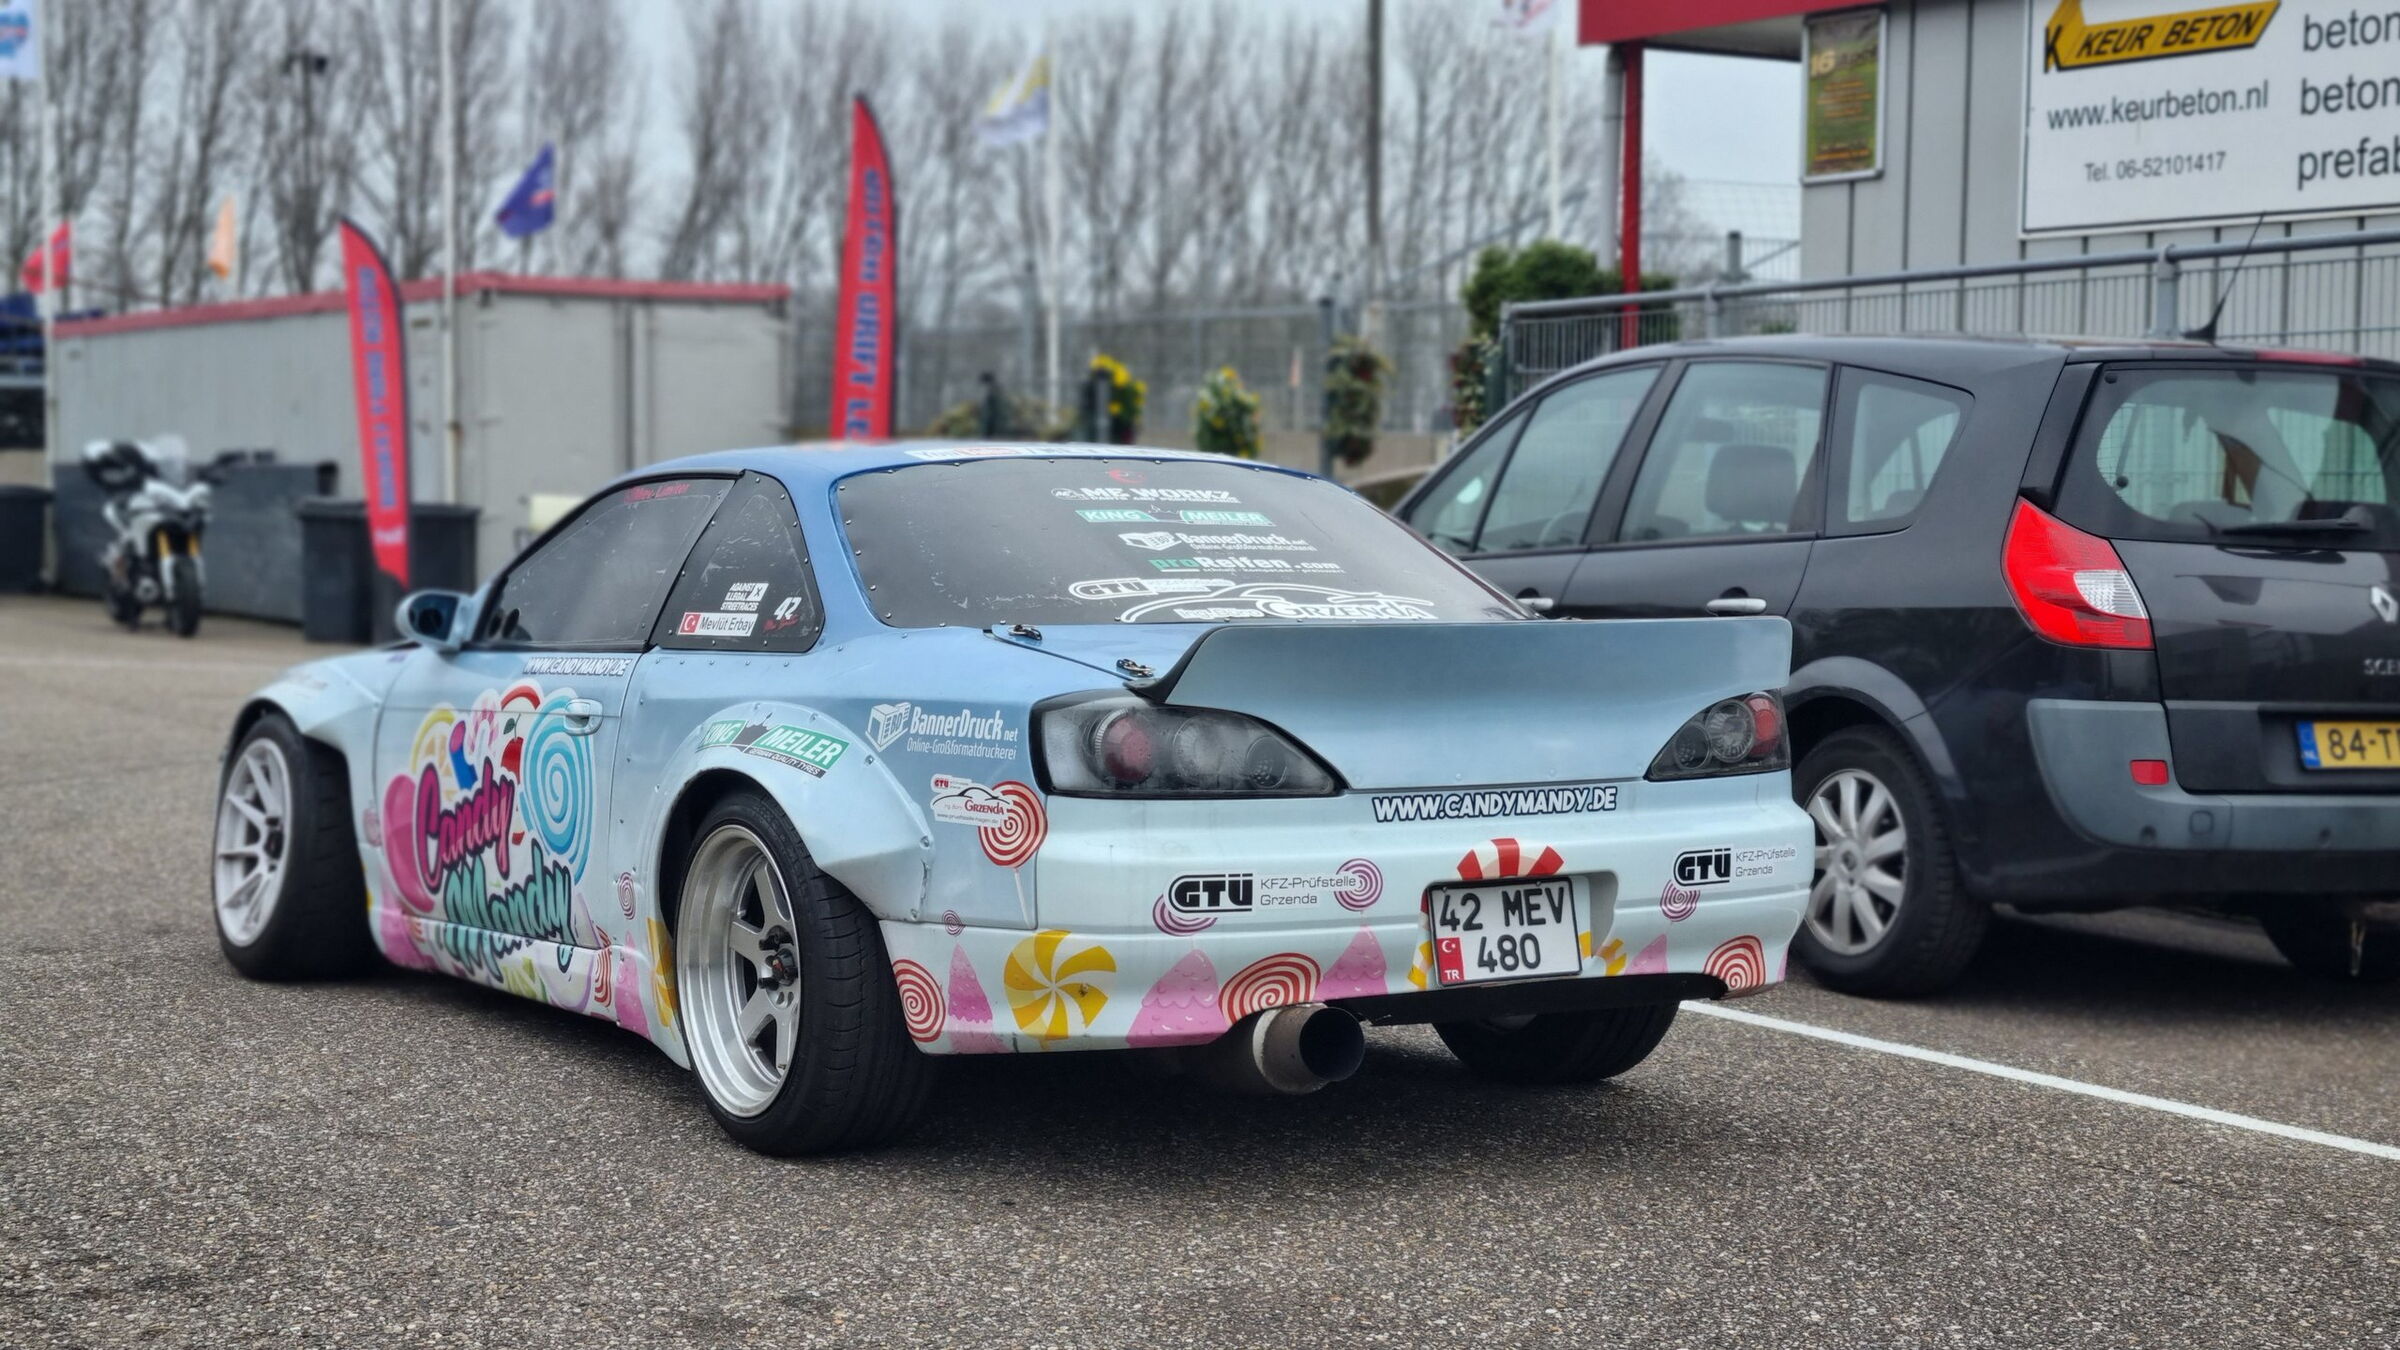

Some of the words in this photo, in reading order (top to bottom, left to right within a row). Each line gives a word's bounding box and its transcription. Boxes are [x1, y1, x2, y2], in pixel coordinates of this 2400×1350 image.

[2076, 24, 2154, 58] KEUR
[2161, 11, 2264, 48] BETON
[2047, 80, 2269, 130] www.keurbeton.nl
[2085, 162, 2111, 182] Tel.
[2116, 151, 2226, 180] 06-52101417
[1129, 488, 1231, 500] WORKZ
[1084, 511, 1141, 520] KING
[1186, 511, 1264, 523] MEILER
[720, 602, 760, 611] STREETRACES
[774, 597, 802, 620] 42
[700, 616, 729, 631] Mevlüt
[728, 616, 754, 634] Erbay
[910, 706, 1003, 740] BannerDruck
[760, 727, 843, 767] MEILER
[906, 737, 1018, 761] Online-Großformatdruckerei
[771, 753, 799, 768] QUALITY
[797, 762, 821, 776] TYRES
[1372, 786, 1618, 822] WWW.CANDYMANDY.DE
[415, 756, 516, 895] Candy
[1676, 848, 1731, 881] GTÜ
[1735, 847, 1796, 862] KFZ-Prüfstelle
[1735, 865, 1773, 878] Grzenda
[1172, 873, 1254, 908] GTÜ
[1260, 877, 1358, 890] KFZ-Prüfstelle
[1260, 894, 1318, 906] Grzenda
[1439, 892, 1483, 932] 42
[1501, 886, 1565, 928] MEV
[1477, 932, 1541, 973] 480
[1445, 969, 1460, 981] TR
